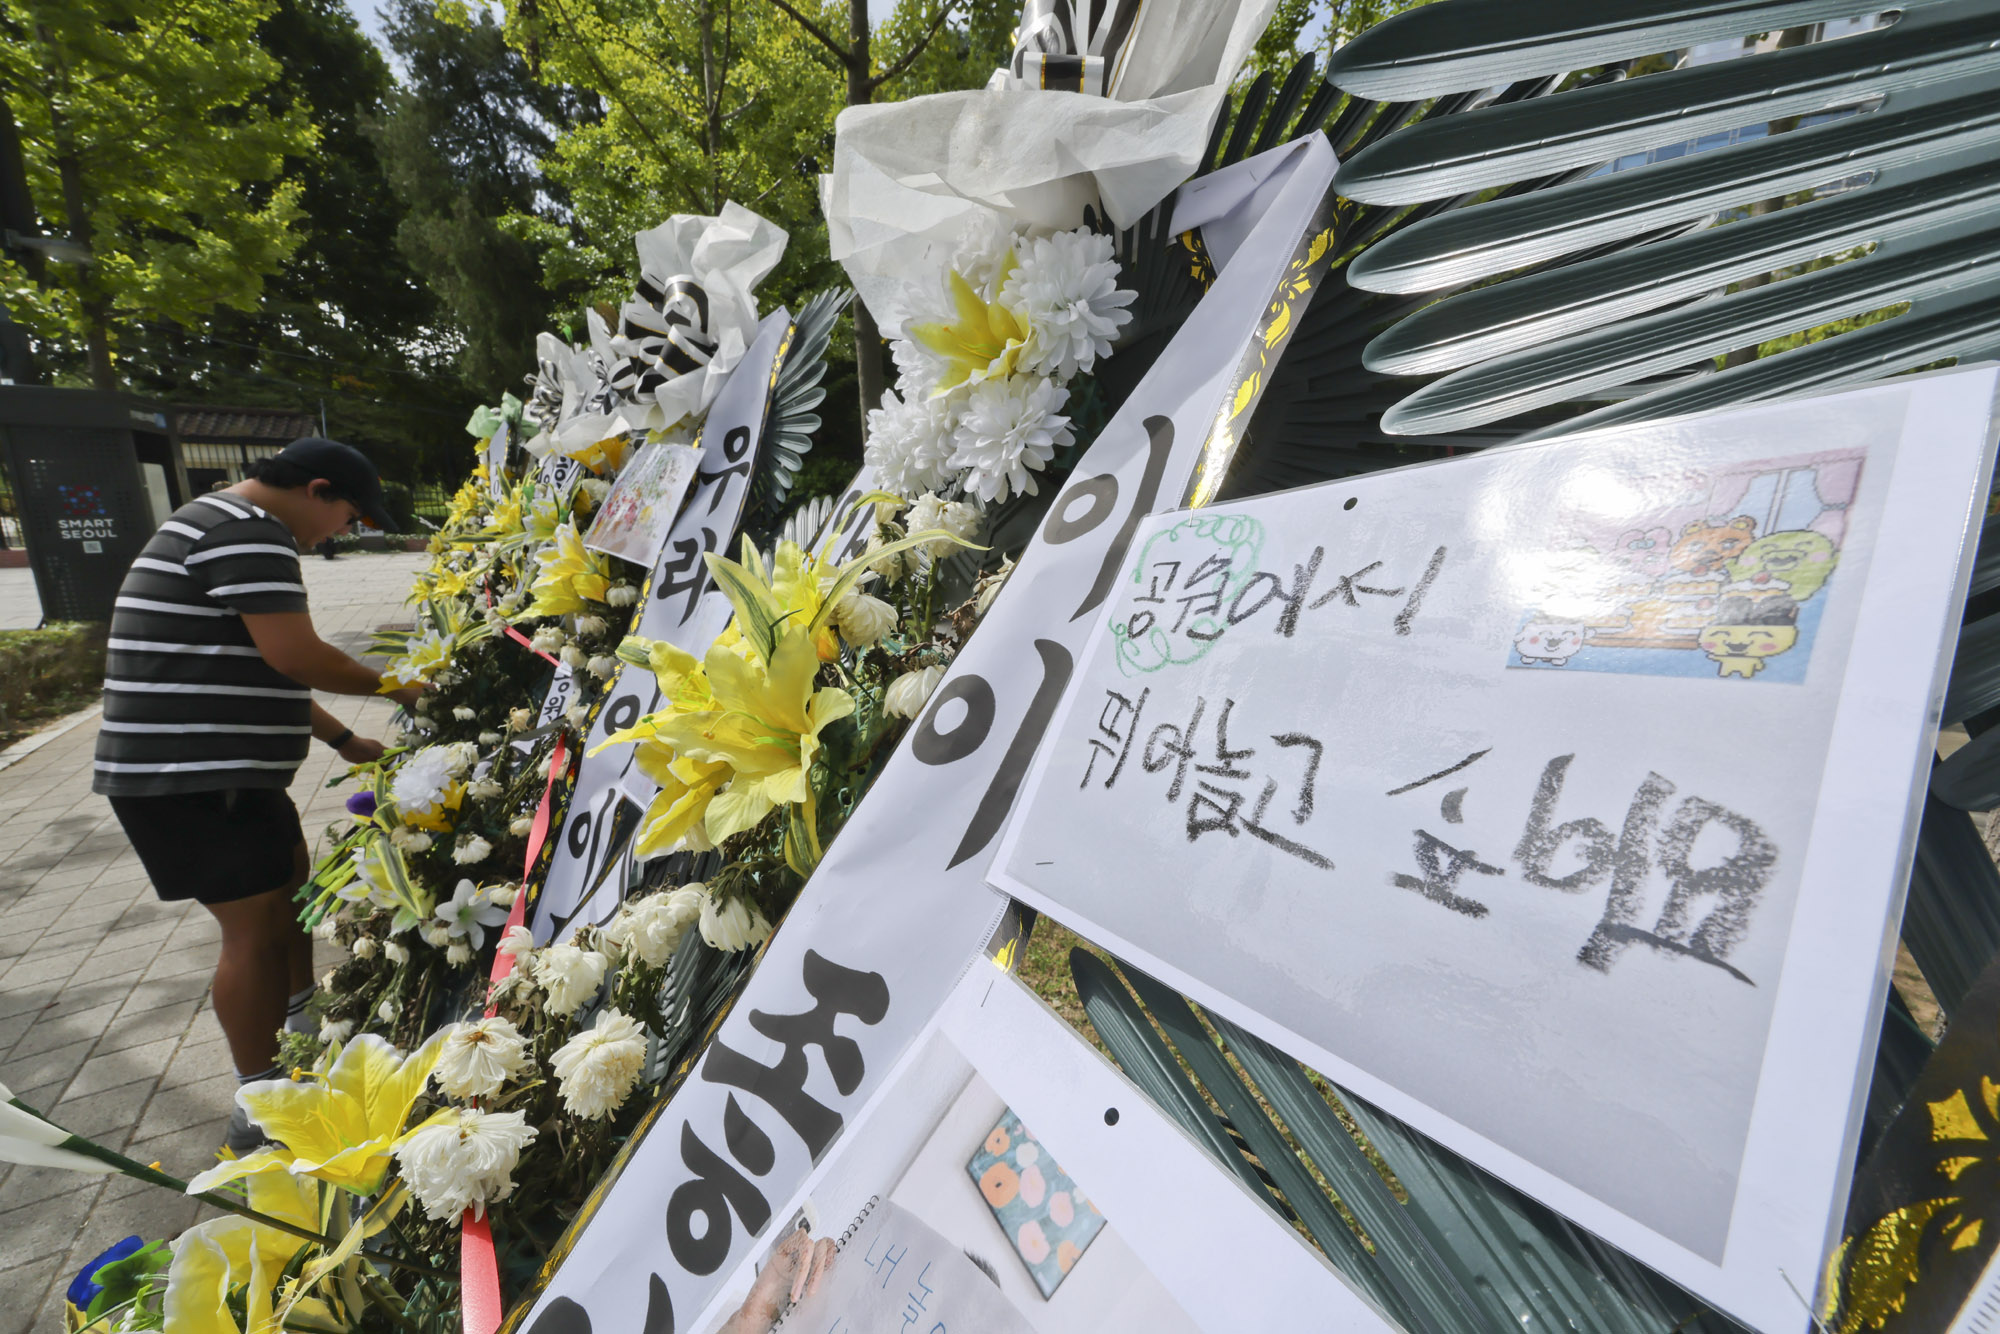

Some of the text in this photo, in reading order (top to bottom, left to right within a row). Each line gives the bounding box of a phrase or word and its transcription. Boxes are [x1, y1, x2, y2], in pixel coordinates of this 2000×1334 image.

[58, 519, 114, 529] SMART
[657, 425, 750, 628] 우리
[61, 529, 118, 539] SEOUL
